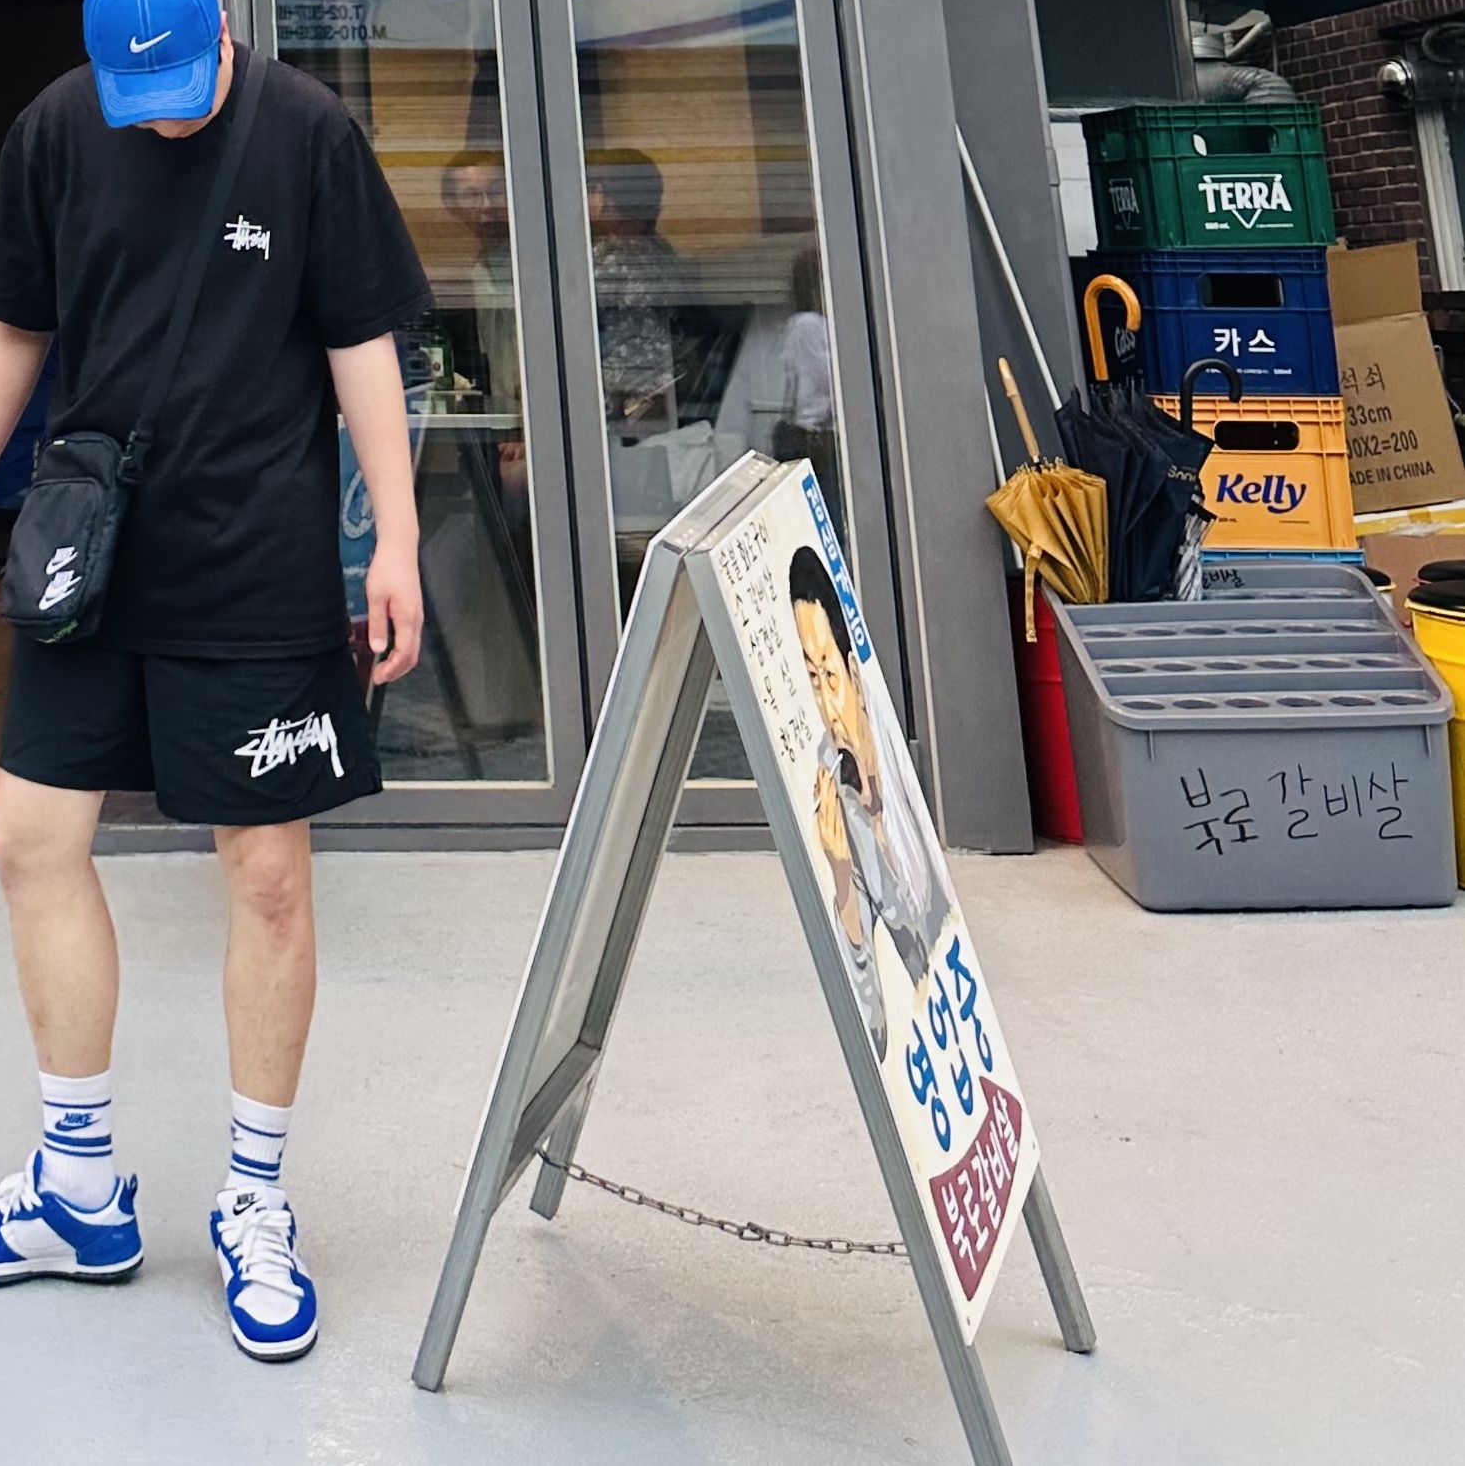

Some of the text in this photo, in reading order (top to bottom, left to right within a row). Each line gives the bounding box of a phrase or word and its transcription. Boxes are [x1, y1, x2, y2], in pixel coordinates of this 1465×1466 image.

[1198, 180, 1292, 213] TERRA
[1213, 328, 1276, 357] 카스
[1349, 460, 1435, 486] ADE IN CHINA
[1216, 473, 1307, 514] Kelly
[906, 935, 993, 1152] 영업중
[63, 1112, 93, 1124] NIKE
